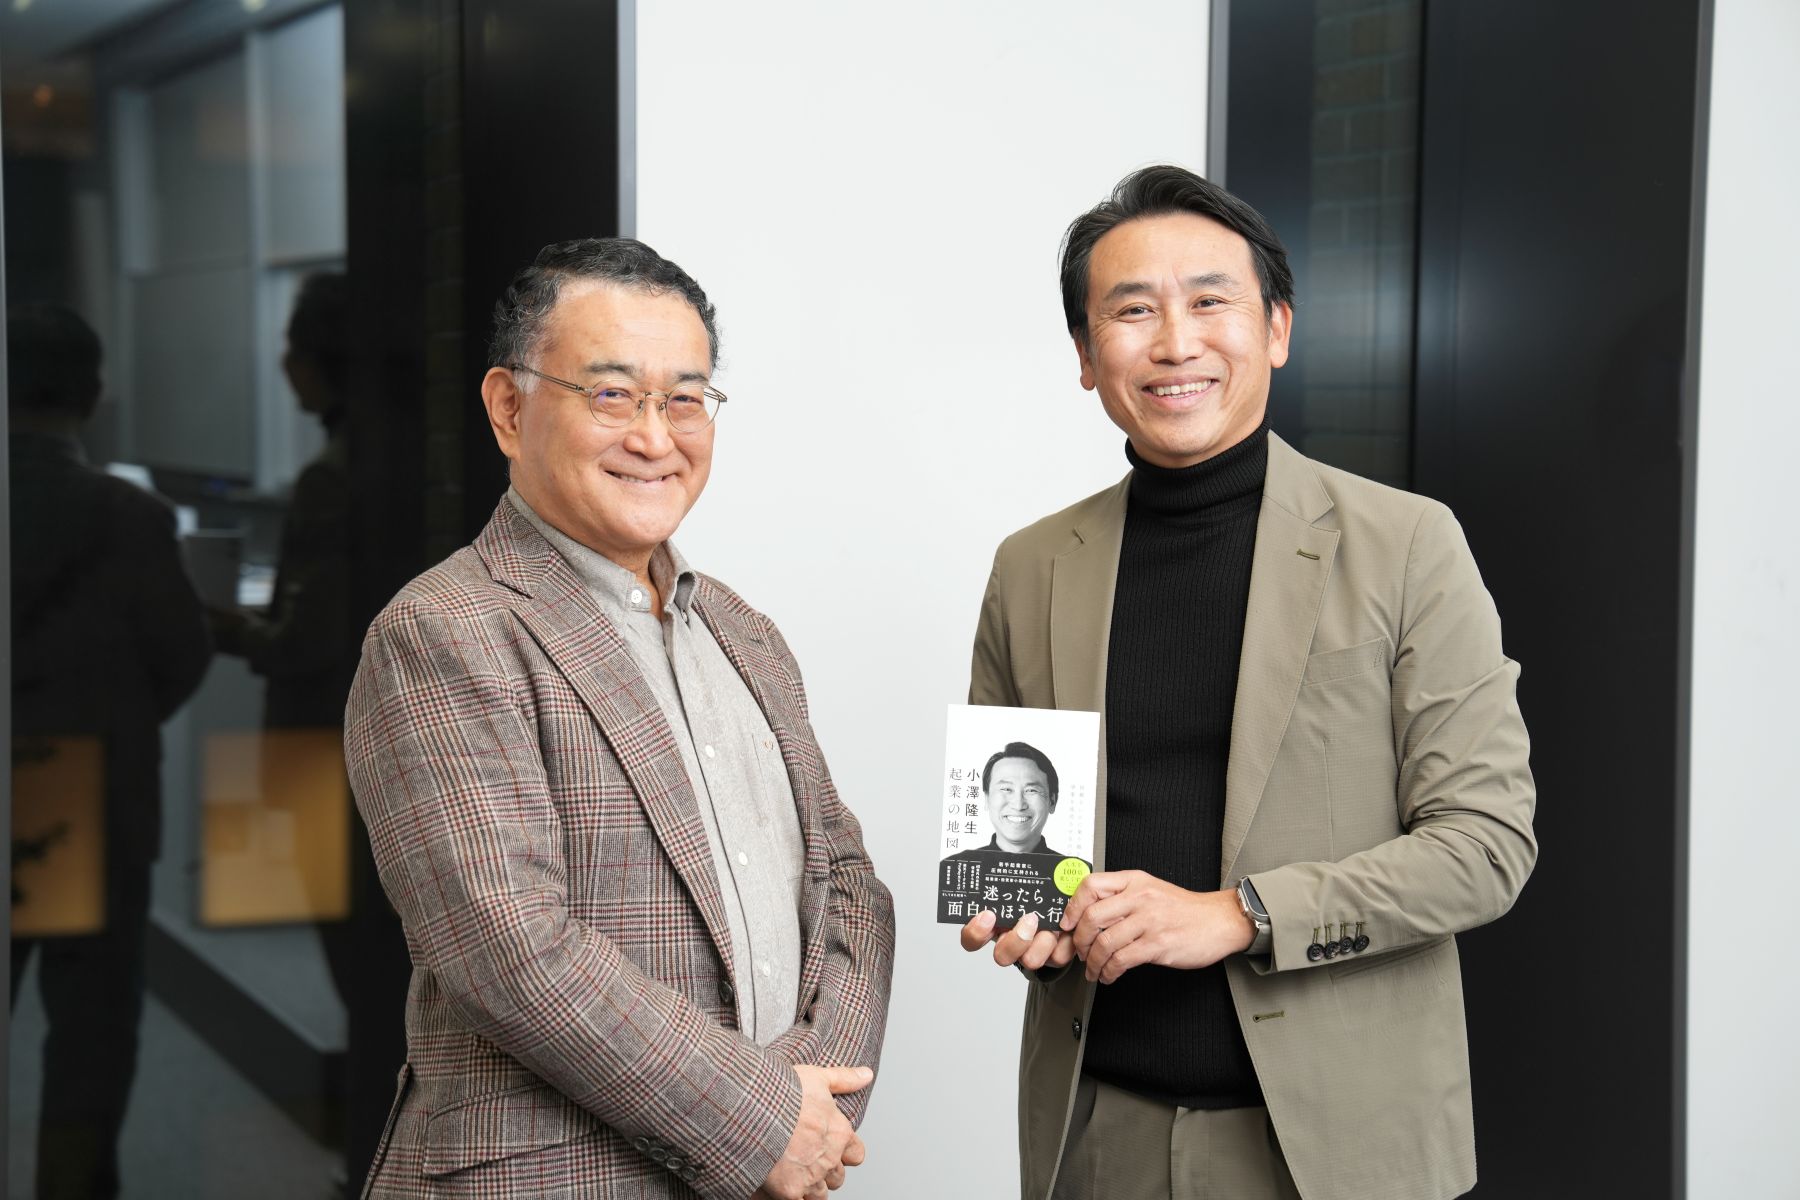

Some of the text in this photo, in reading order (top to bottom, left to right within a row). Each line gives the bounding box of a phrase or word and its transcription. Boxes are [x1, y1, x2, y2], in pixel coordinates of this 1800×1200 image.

[946, 767, 962, 849] 起業の地図
[964, 768, 980, 835] 小澤隆生
[983, 885, 1043, 904] 迷ったら
